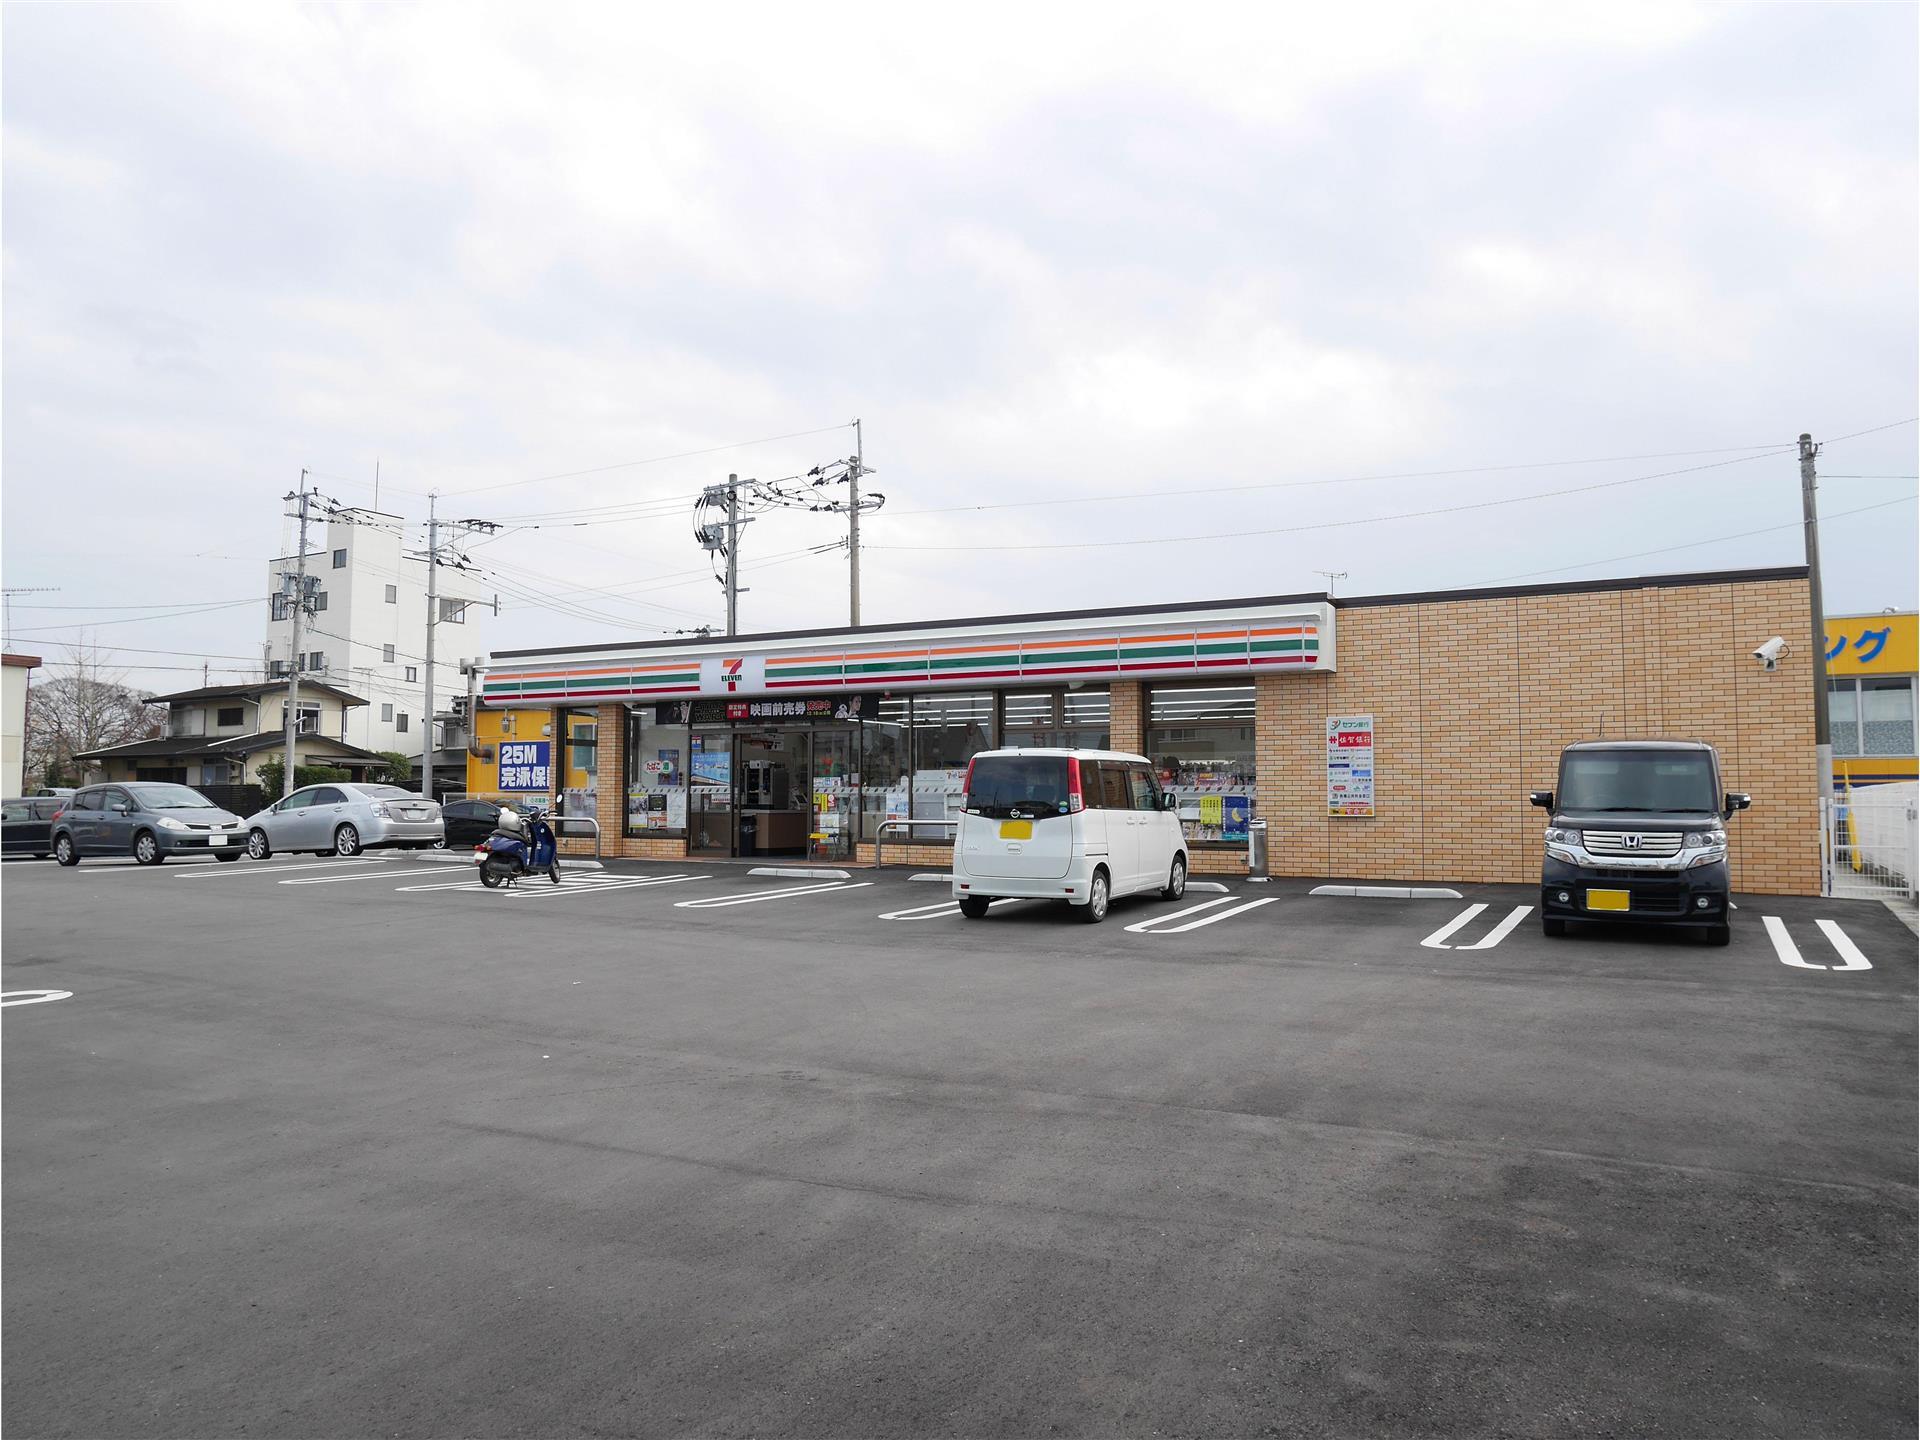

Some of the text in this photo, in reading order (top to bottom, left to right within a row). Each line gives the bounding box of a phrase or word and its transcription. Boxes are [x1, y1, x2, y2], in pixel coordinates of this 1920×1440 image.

[750, 702, 806, 716] 映画前売券
[502, 745, 536, 764] 25M
[646, 762, 660, 770] たばこ
[502, 766, 550, 787] 完泳保
